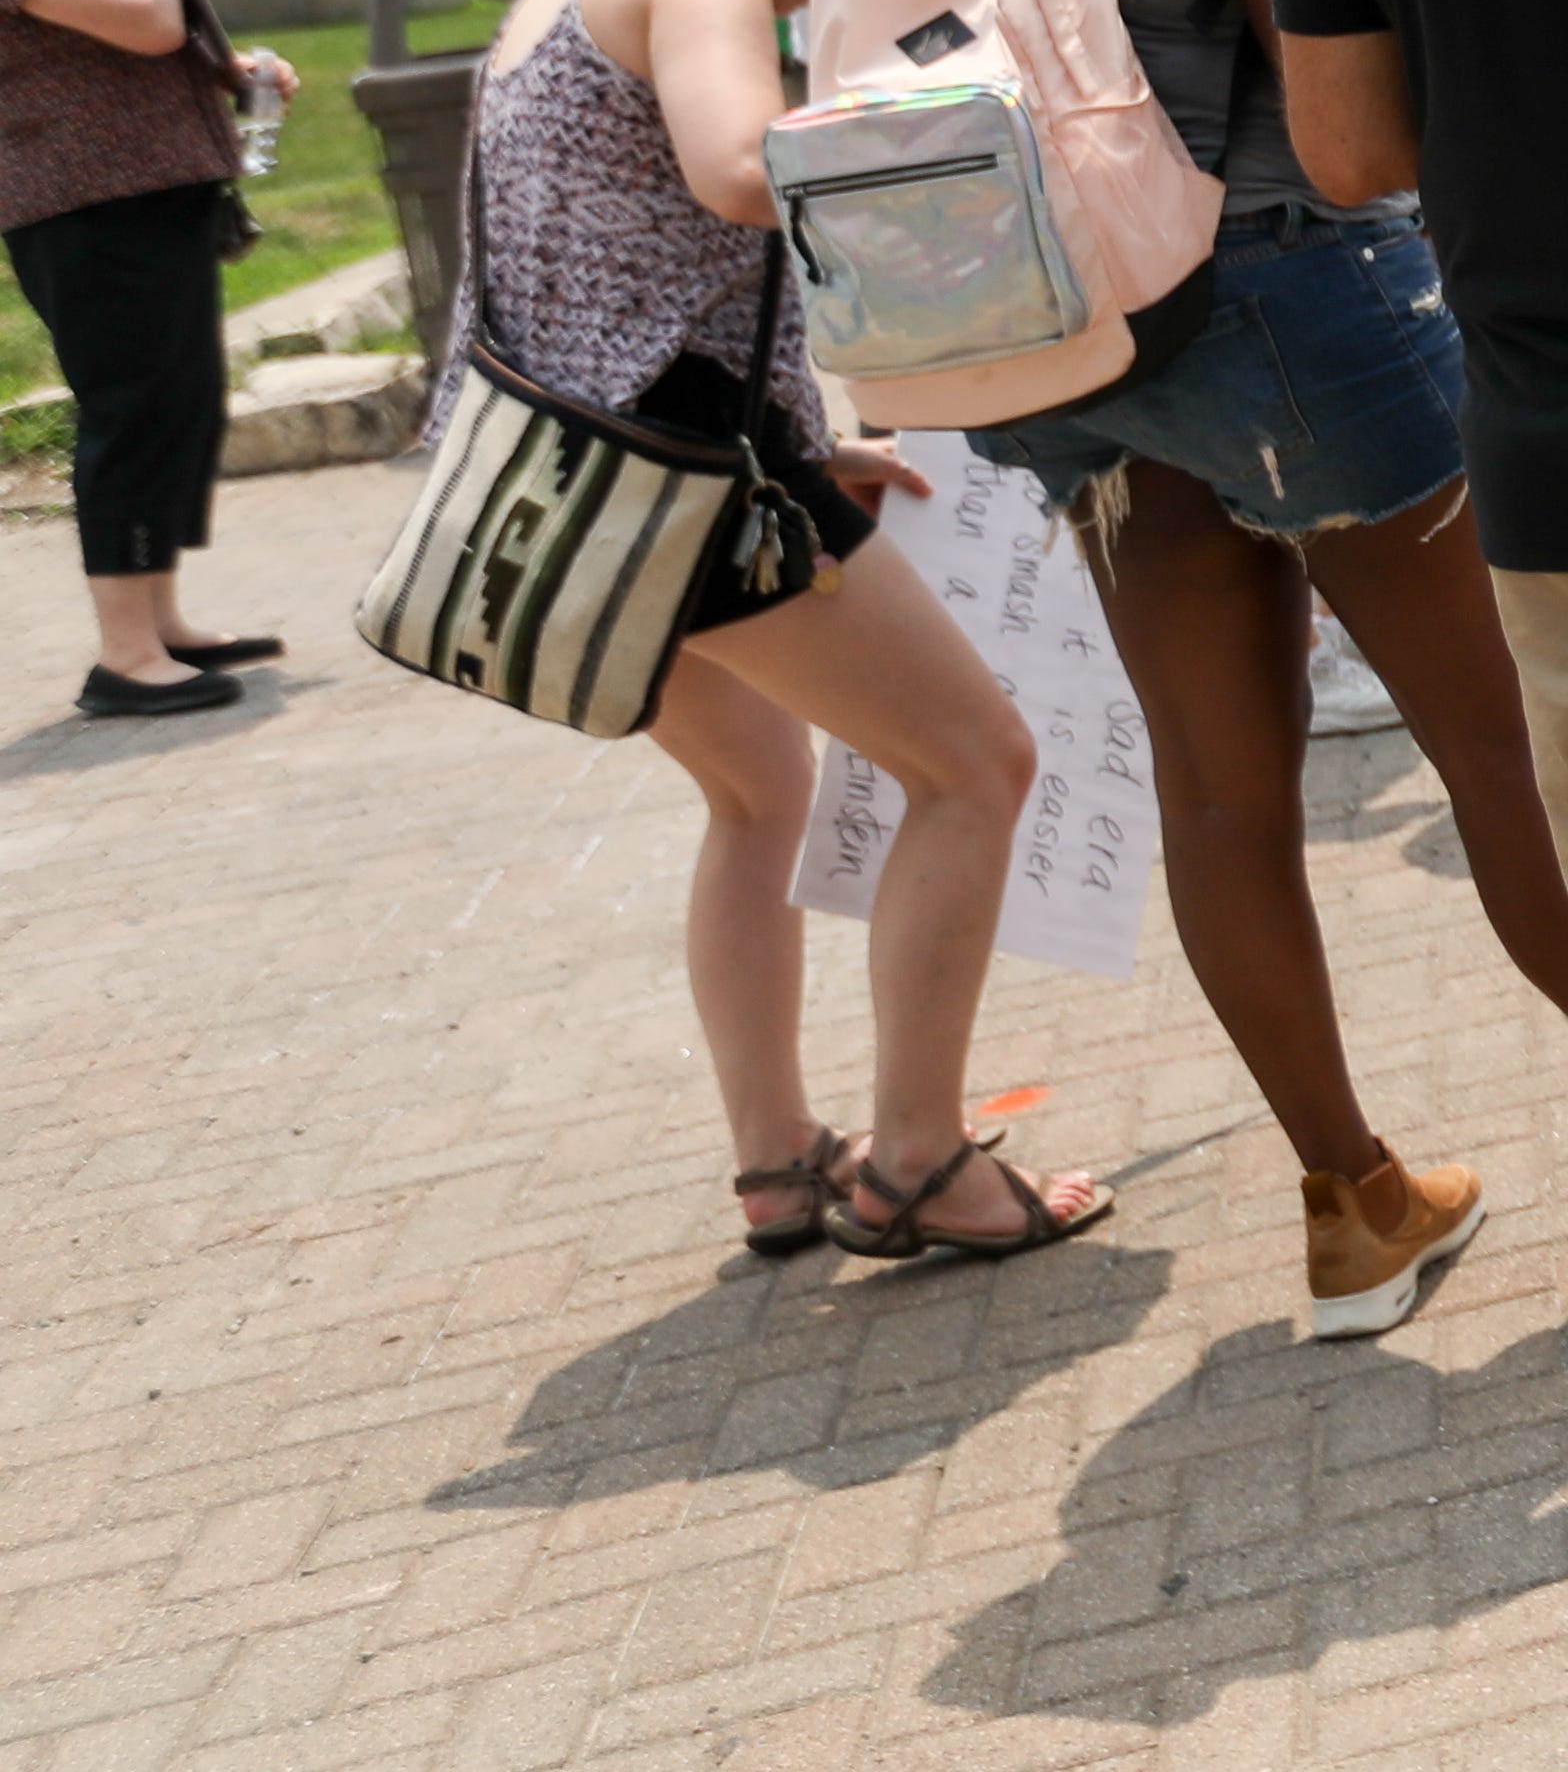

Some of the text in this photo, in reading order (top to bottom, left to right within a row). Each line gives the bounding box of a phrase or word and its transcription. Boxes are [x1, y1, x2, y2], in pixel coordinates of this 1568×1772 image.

[945, 460, 1006, 603] than a
[1025, 627, 1100, 898] it is easier
[1081, 813, 1126, 895] era
